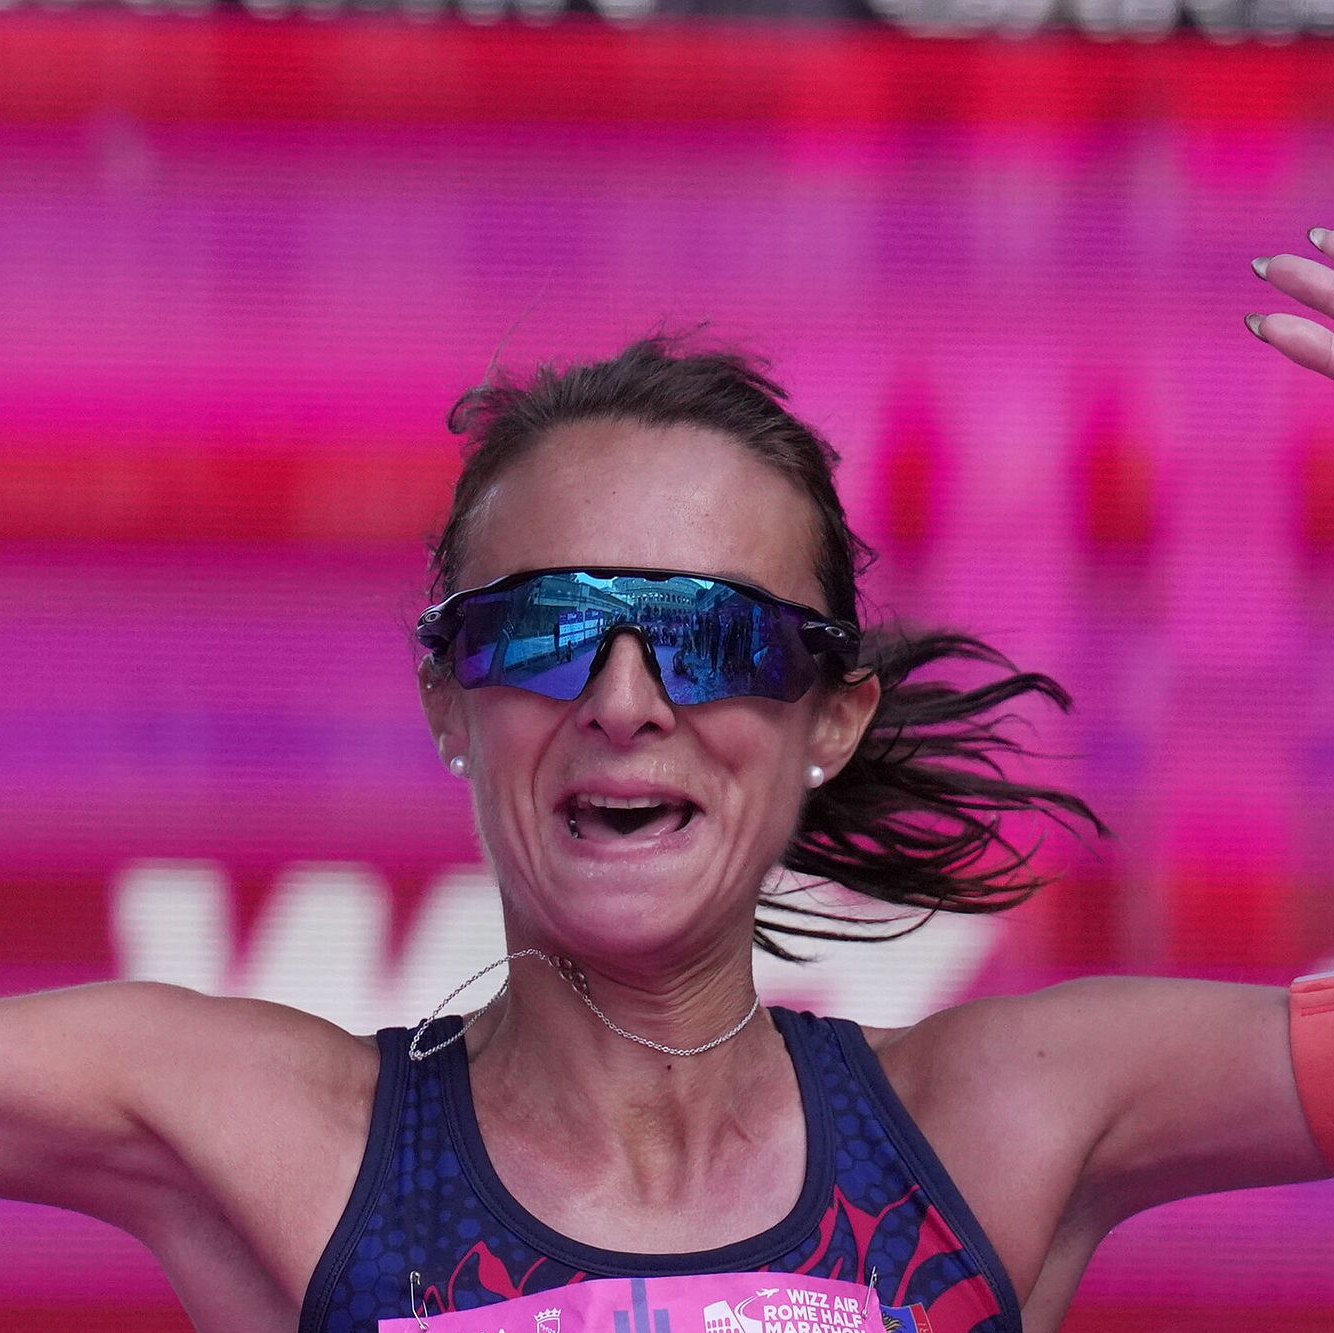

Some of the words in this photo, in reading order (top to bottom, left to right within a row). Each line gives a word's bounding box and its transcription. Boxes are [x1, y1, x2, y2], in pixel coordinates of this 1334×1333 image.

[786, 1288, 830, 1309] WIZZ
[833, 1296, 860, 1313] AIR
[763, 1304, 818, 1322] ROME
[821, 1309, 863, 1329] HALF
